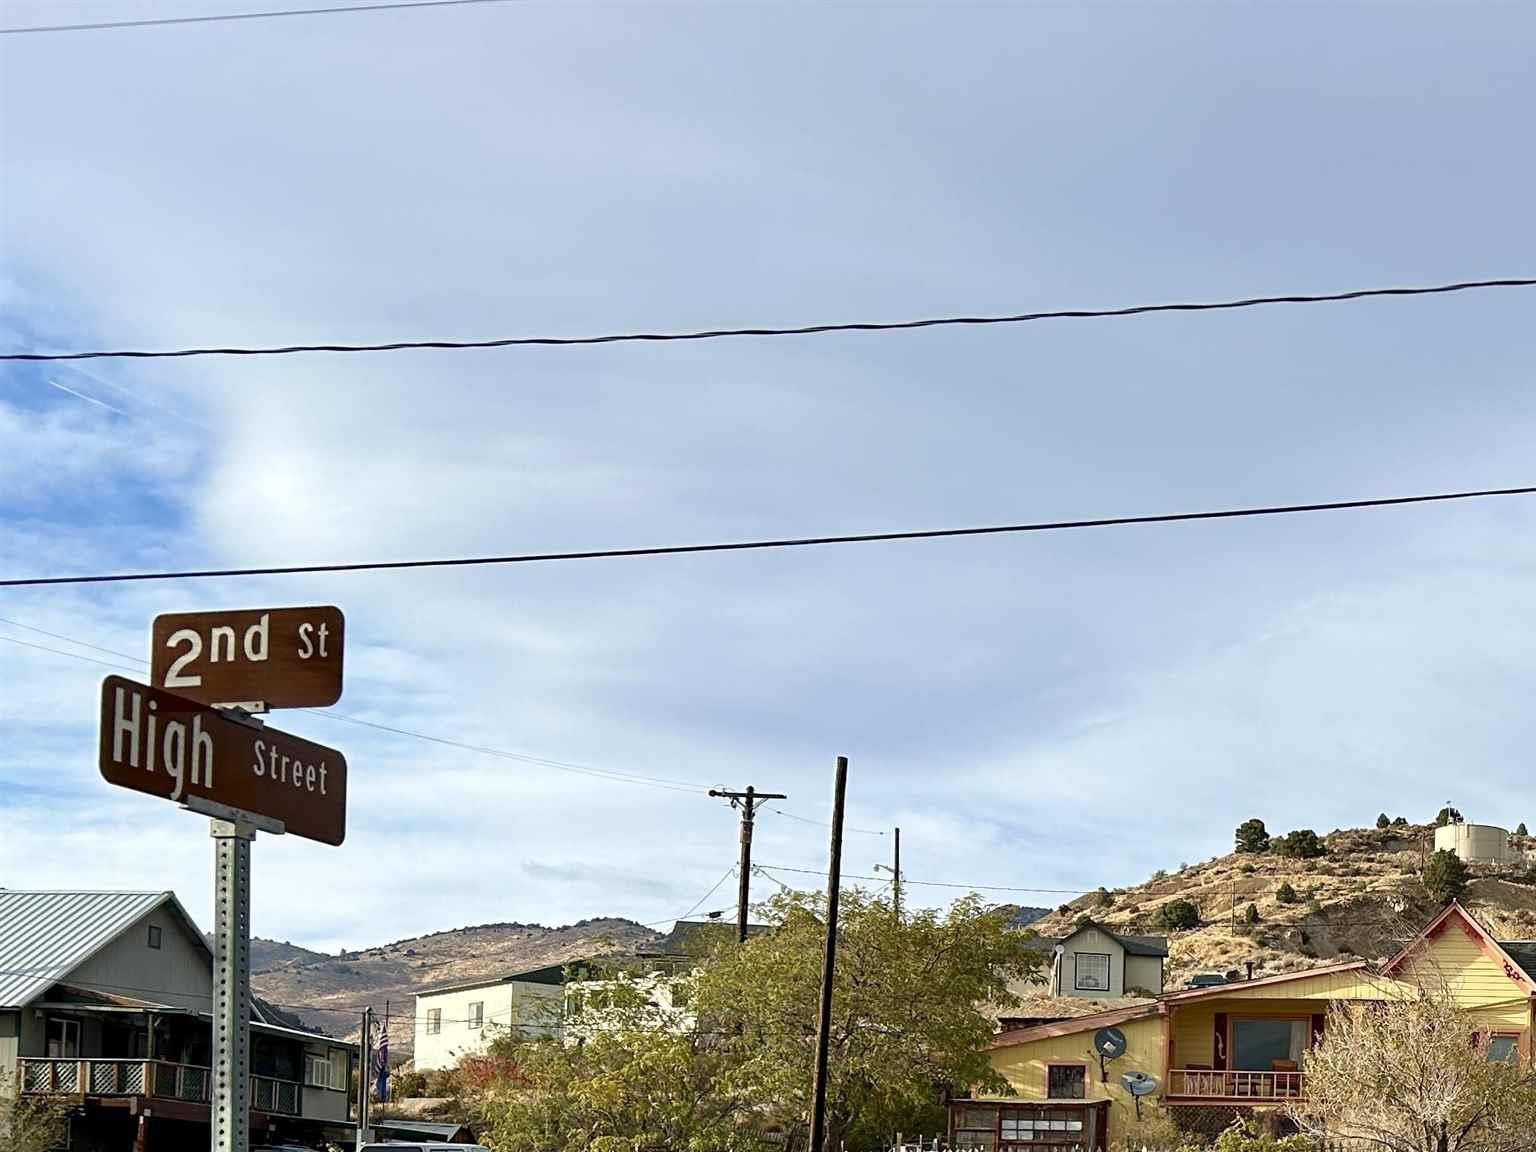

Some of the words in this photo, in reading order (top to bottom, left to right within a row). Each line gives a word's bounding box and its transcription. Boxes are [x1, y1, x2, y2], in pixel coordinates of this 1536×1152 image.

[164, 613, 270, 688] 2nd
[297, 622, 329, 659] St
[111, 687, 213, 801] High
[251, 739, 328, 795] Street
